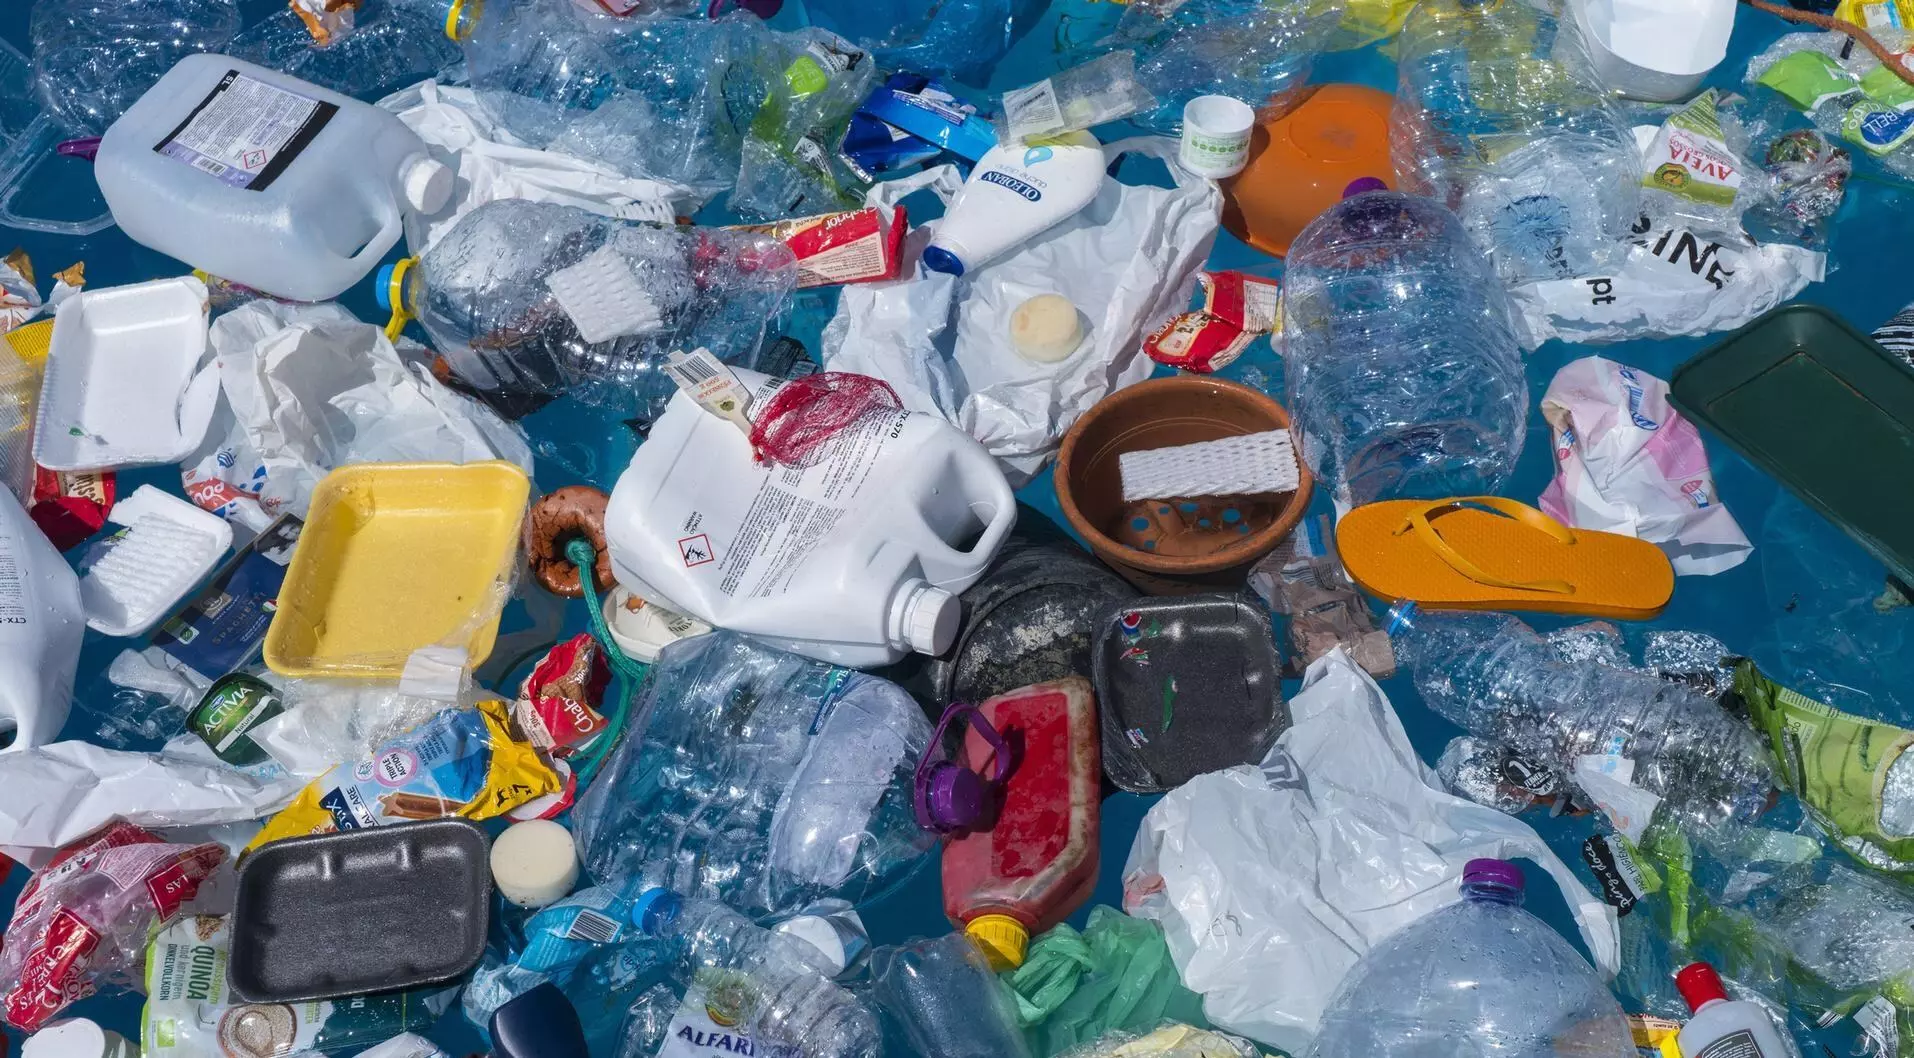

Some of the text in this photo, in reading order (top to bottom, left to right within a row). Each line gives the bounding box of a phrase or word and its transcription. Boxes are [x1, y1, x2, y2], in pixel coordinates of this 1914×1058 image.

[221, 75, 234, 86] 5L
[1669, 144, 1734, 181] AVEIA
[985, 172, 1038, 200] OLEOBAN
[1586, 278, 1616, 306] pt
[203, 687, 255, 736] ACTIVIA
[234, 714, 256, 734] Natural
[382, 759, 398, 781] TRIPLE
[390, 753, 407, 776] ACTION
[159, 943, 176, 1001] DINKELVOLLKORN
[186, 945, 216, 1001] QUINOA
